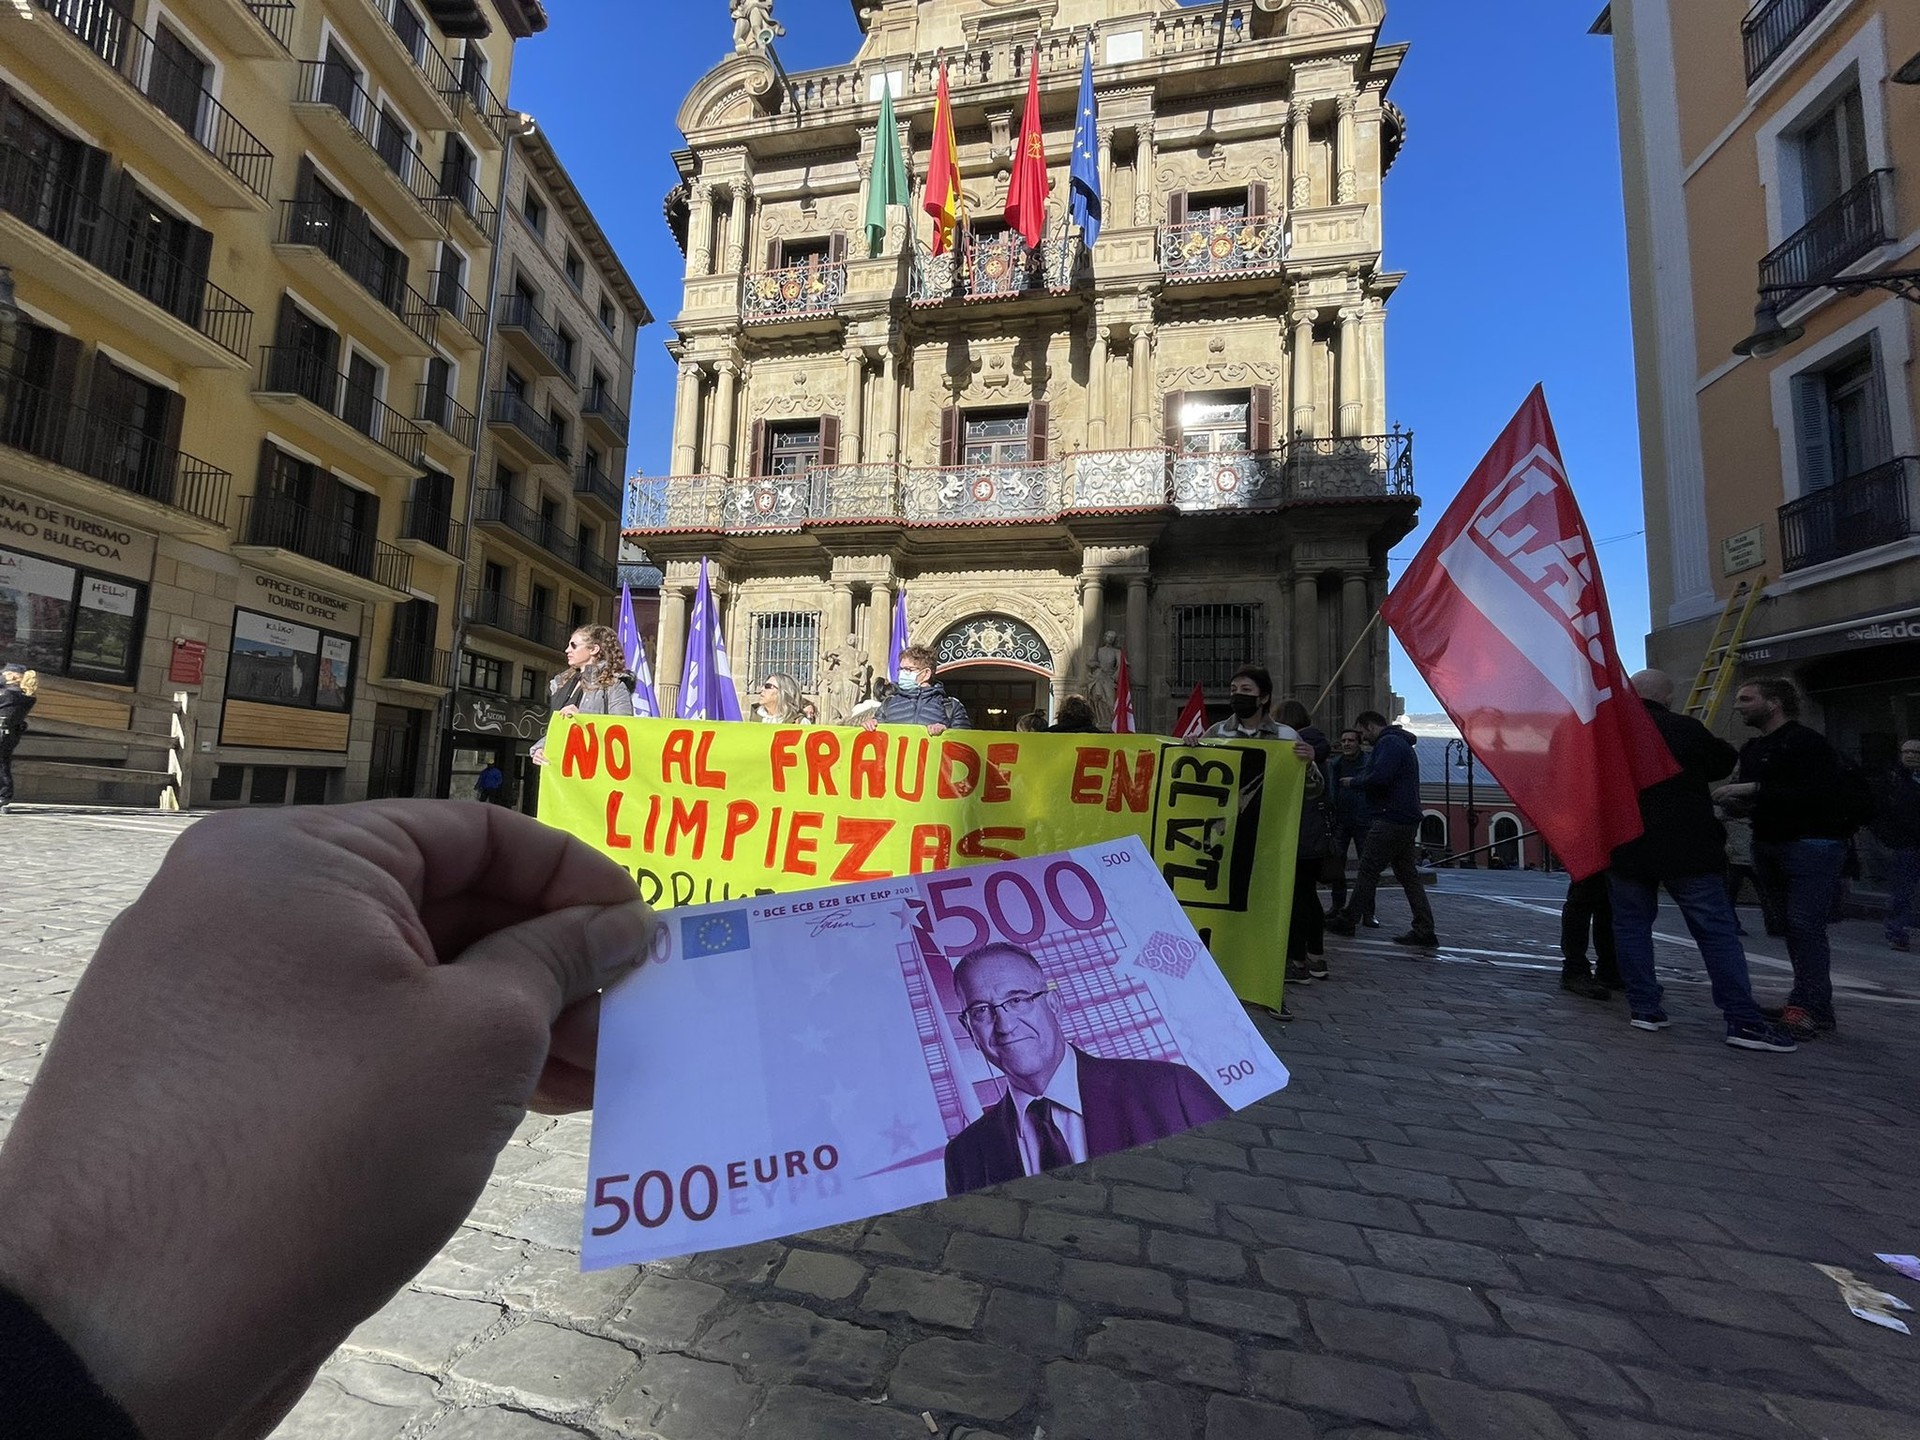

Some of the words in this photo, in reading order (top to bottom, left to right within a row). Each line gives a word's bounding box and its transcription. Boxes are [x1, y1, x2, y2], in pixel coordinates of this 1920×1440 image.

[0, 495, 29, 516] NA
[34, 506, 59, 524] DE
[63, 513, 131, 546] TURISMO
[43, 528, 122, 561] BULEGOA
[255, 575, 291, 594] OFFICE
[292, 586, 306, 598] DE
[308, 591, 349, 612] TOURISME
[267, 593, 305, 613] TOURIST
[306, 605, 337, 621] OFFICE
[562, 722, 631, 780] NO
[662, 729, 726, 790] AL
[770, 729, 1019, 803] FRAUDE
[1070, 746, 1156, 814] EN
[606, 790, 1026, 882] LIMPIEZAS
[1101, 850, 1131, 868] 500
[764, 906, 786, 918] BCE
[792, 902, 814, 913] ECB
[818, 898, 840, 909] EZB
[845, 894, 866, 905] EKT
[870, 890, 891, 901] EKP
[895, 886, 914, 895] 2001
[926, 860, 1107, 958] 500
[1143, 937, 1196, 970] 500
[1216, 1059, 1255, 1086] 500
[591, 1164, 718, 1236] 500
[727, 1144, 838, 1189] EURO
